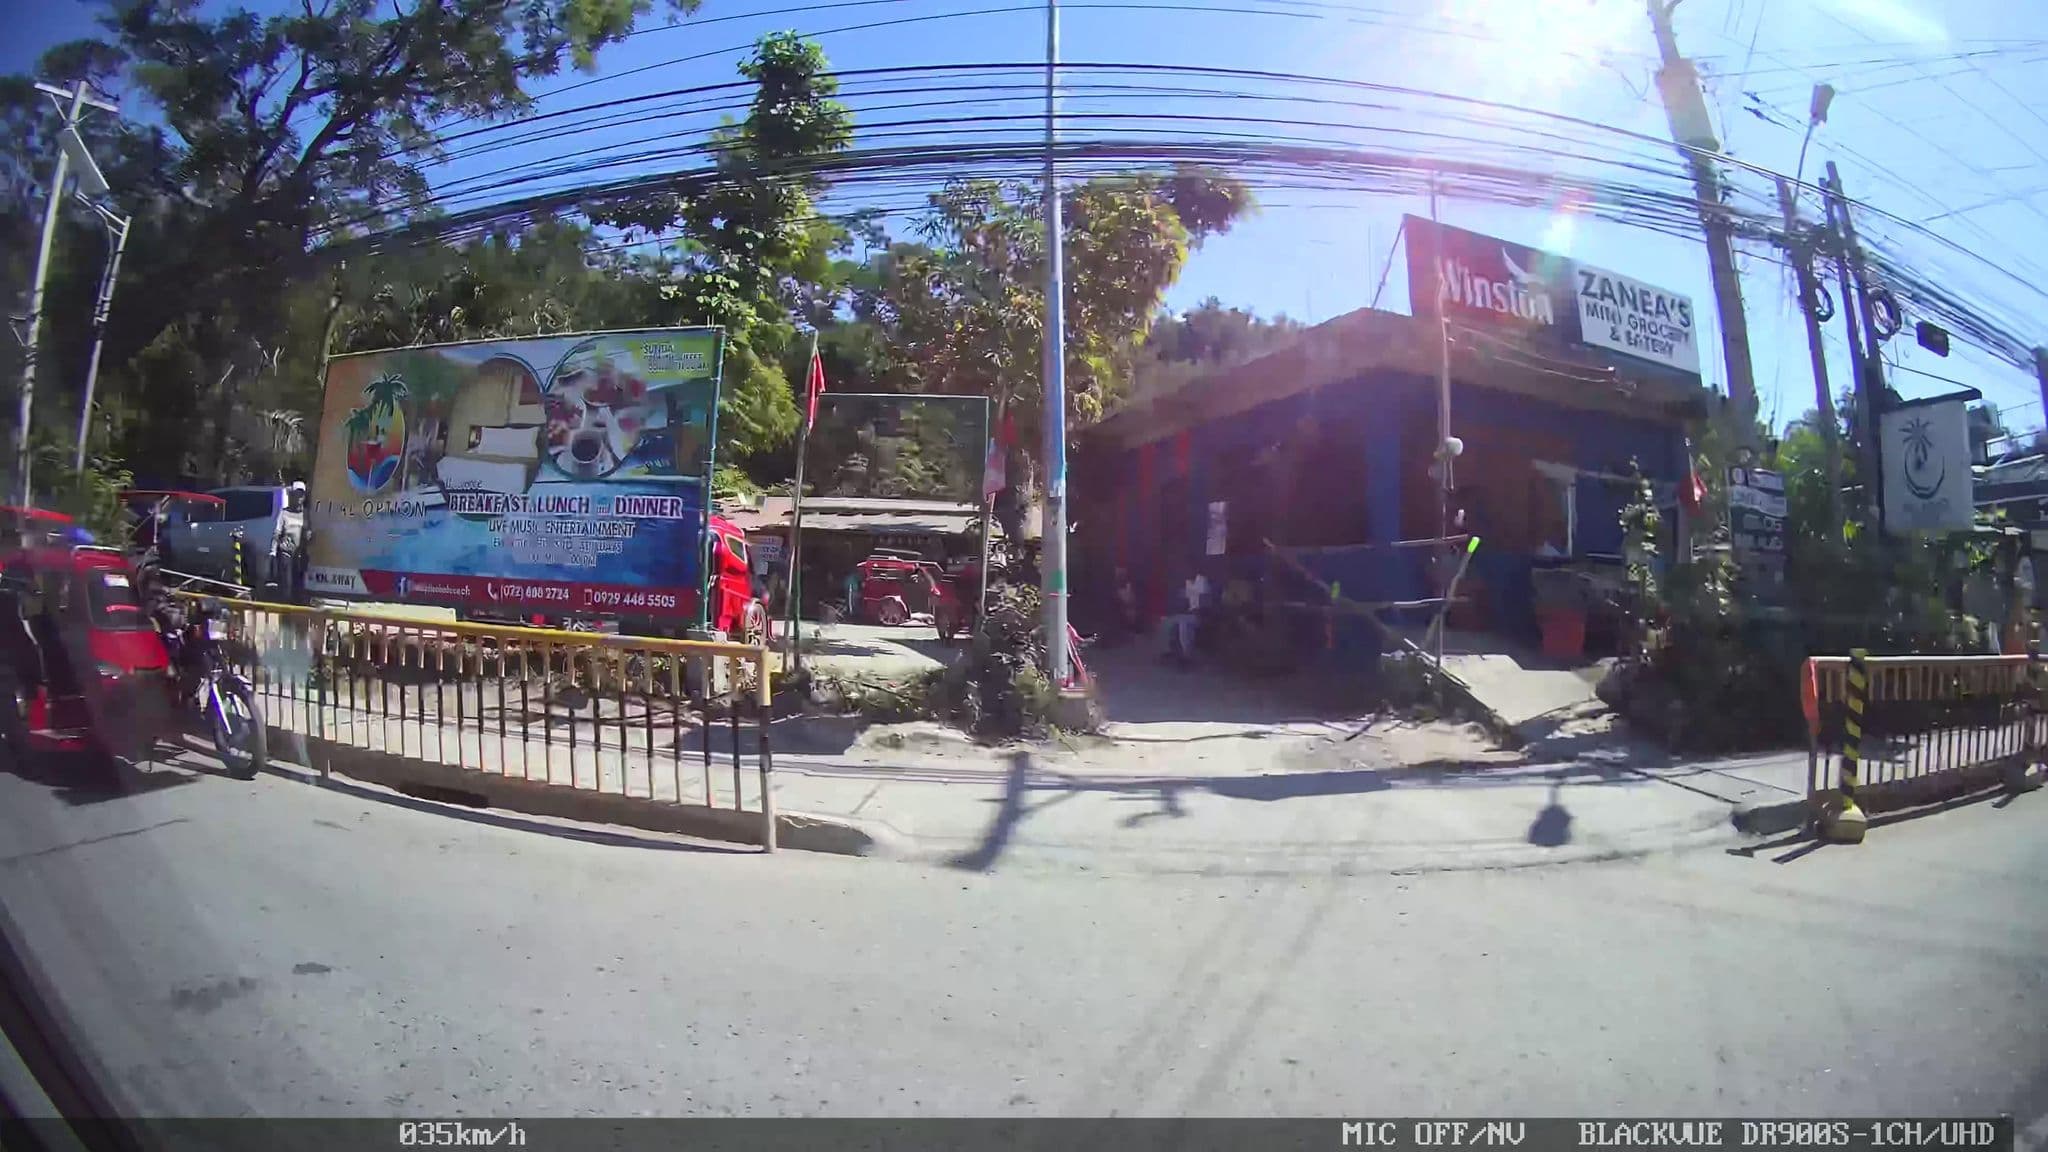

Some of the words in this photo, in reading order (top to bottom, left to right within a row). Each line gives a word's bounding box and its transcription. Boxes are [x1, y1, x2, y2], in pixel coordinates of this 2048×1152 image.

[1439, 257, 1554, 325] Winston
[1578, 270, 1691, 328] ZANEA'S
[1585, 302, 1622, 325] MINI
[1628, 313, 1689, 344] GROCY
[1609, 326, 1621, 342] &
[362, 498, 426, 519] OPTION
[537, 496, 589, 514] LUNCH
[615, 497, 682, 518] DINNER
[545, 520, 636, 538] ENTERTAINMENT
[545, 587, 569, 601] 2724
[593, 591, 621, 606] 0929
[647, 594, 676, 608] 5505
